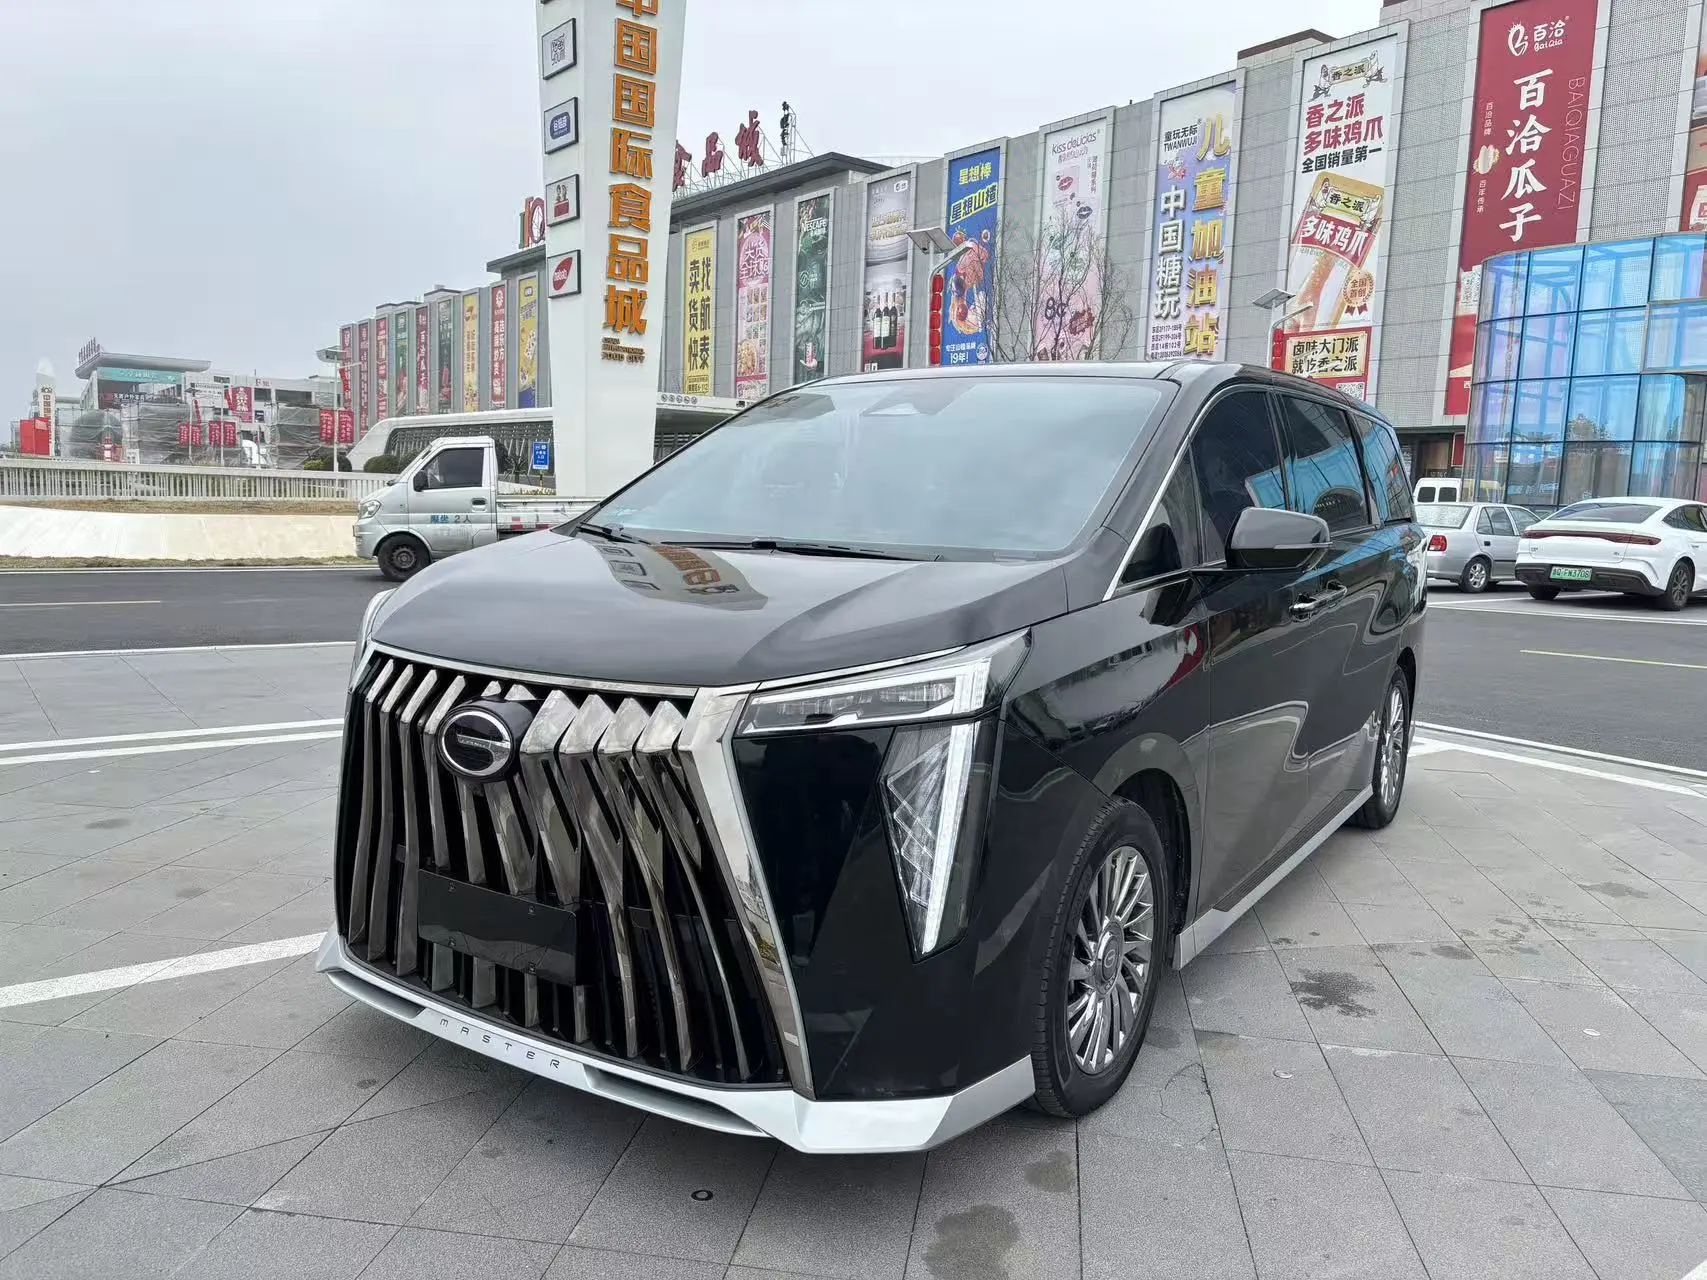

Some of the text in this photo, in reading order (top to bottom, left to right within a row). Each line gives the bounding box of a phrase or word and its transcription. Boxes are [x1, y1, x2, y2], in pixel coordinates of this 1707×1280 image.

[1533, 19, 1566, 42] 百洽
[1331, 63, 1366, 81] 香之派
[1305, 92, 1365, 129] 香之派
[1164, 124, 1198, 142] 童玩无际
[1303, 116, 1384, 156] 多味鸡爪
[1557, 75, 1586, 210] BAIQIAGUAZI
[958, 161, 992, 185] 星想棒
[1301, 146, 1382, 174] 全国销量第一
[1499, 68, 1554, 242] 百洽瓜子
[950, 181, 998, 225] 星想山楂
[1329, 193, 1366, 212] 香之派
[1154, 185, 1186, 319] 中国糖玩
[1184, 114, 1231, 357] 儿童加油站
[1300, 216, 1369, 257] 多味鸡爪
[688, 259, 700, 372] 卖货快
[1291, 354, 1358, 374] 就吃香之派
[1292, 335, 1360, 357] 卤味大门派
[454, 514, 461, 524] 2
[463, 514, 472, 524] 人
[440, 1018, 560, 1069] MASTER
